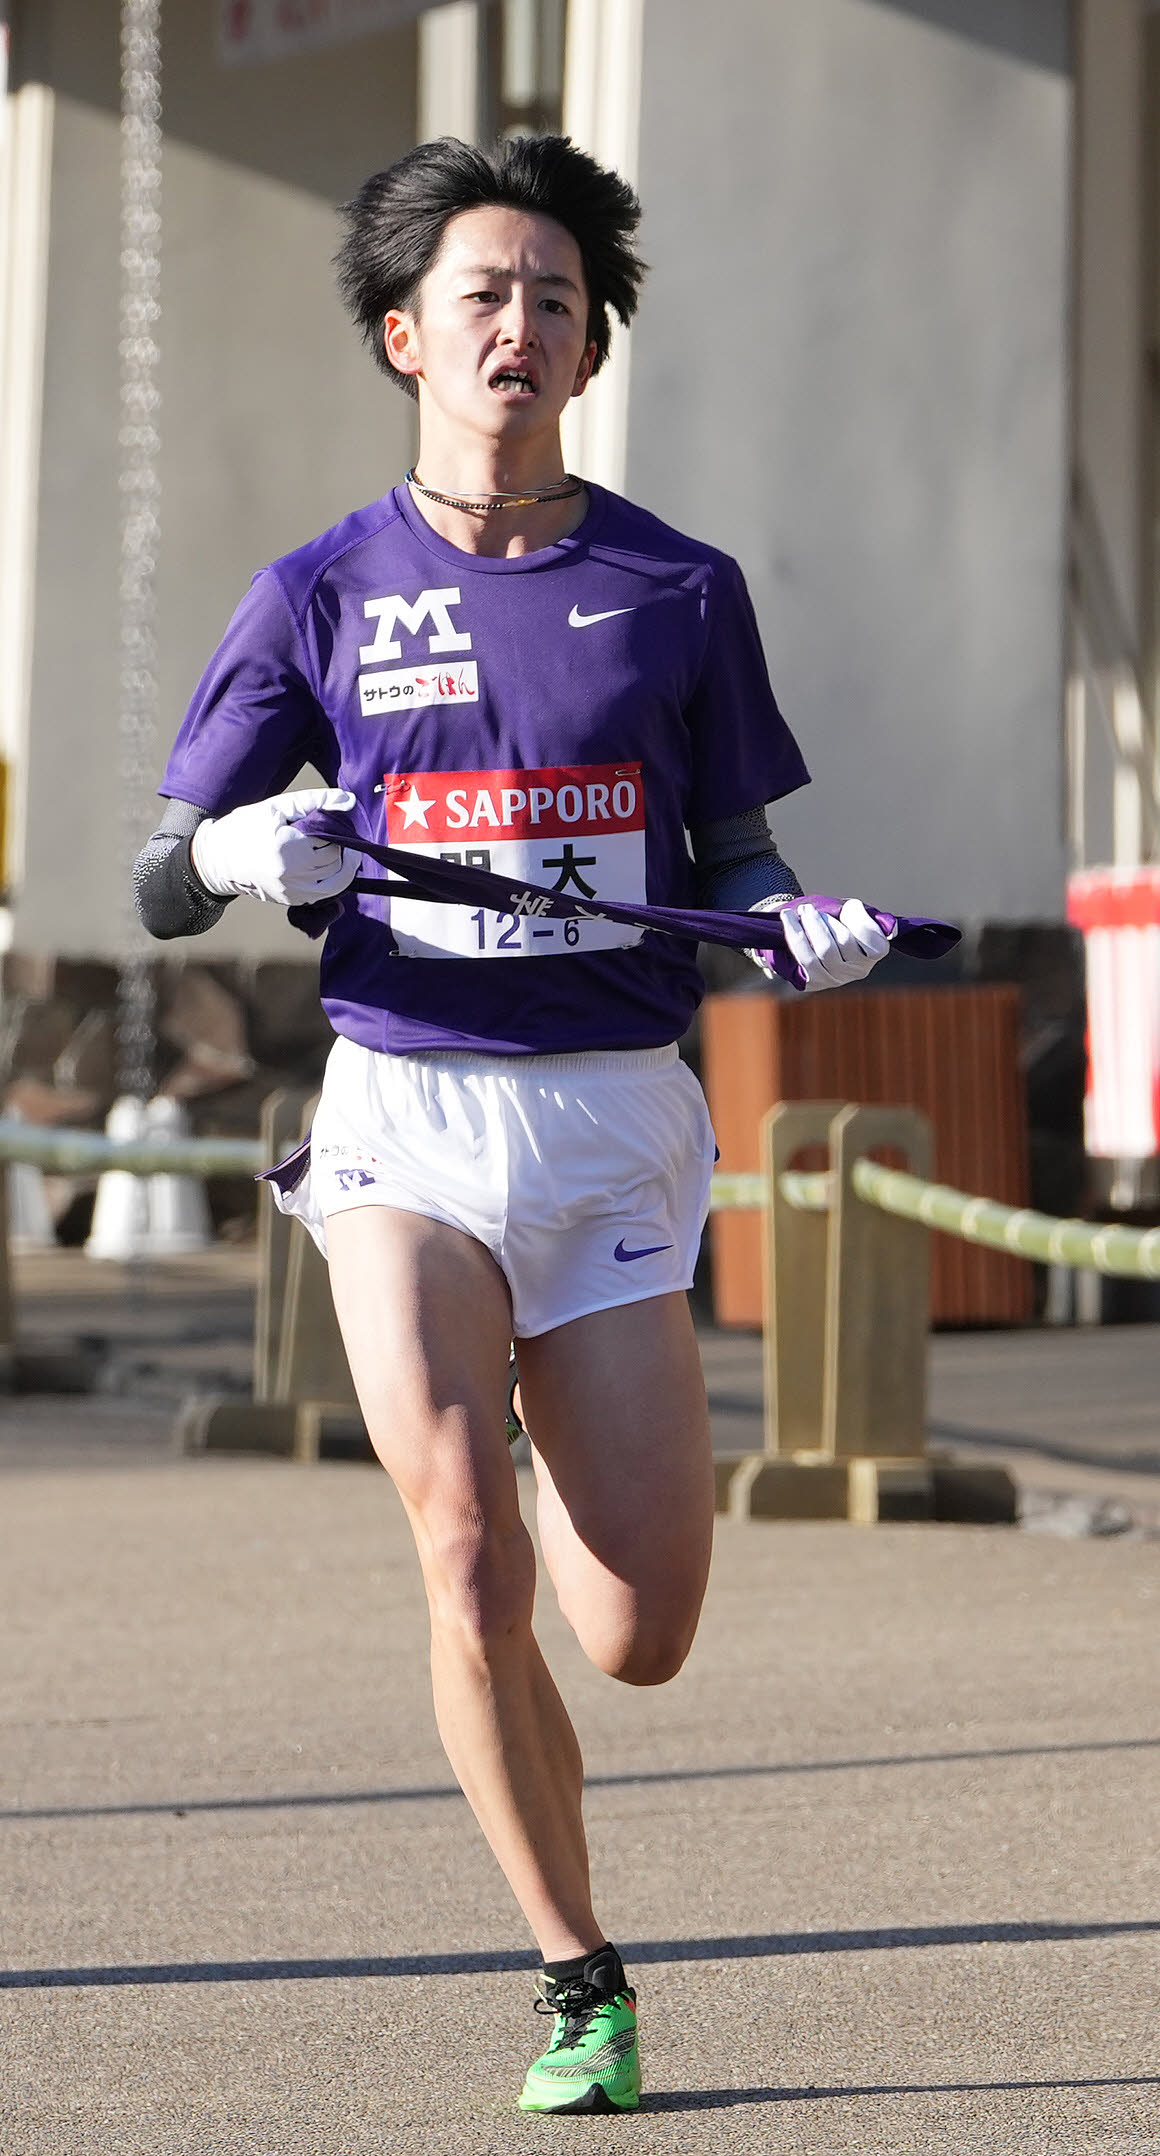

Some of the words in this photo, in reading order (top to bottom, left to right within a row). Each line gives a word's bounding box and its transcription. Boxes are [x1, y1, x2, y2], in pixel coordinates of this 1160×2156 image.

[359, 587, 472, 665] M
[445, 780, 637, 829] SAPPORO
[470, 908, 580, 950] 12-6
